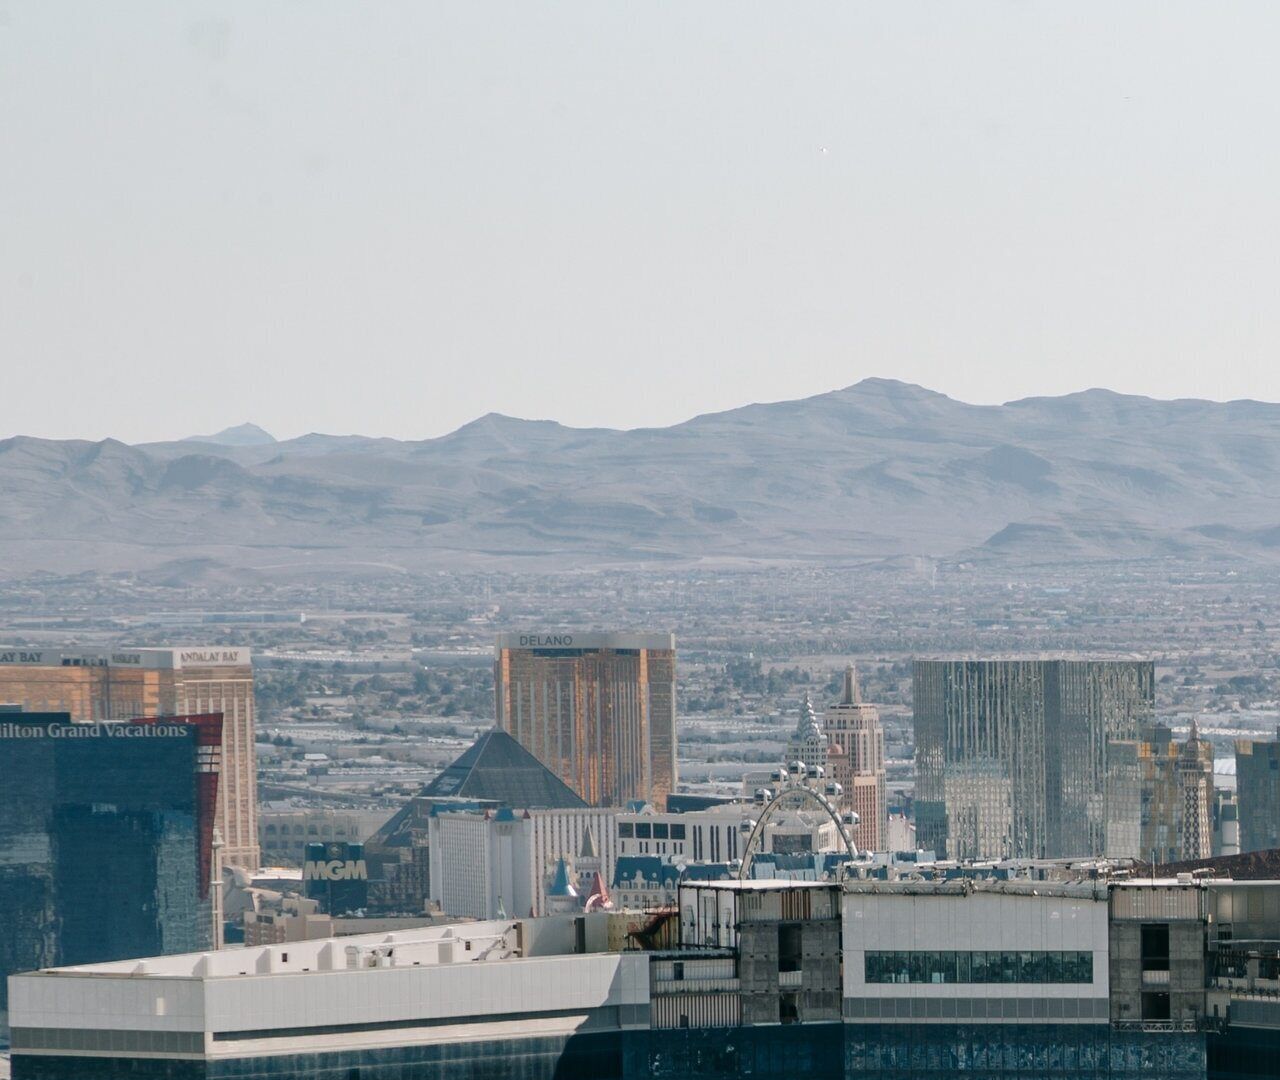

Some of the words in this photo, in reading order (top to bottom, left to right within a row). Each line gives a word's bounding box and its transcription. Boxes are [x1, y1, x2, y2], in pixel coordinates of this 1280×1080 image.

[519, 635, 573, 646] DELANO
[19, 652, 43, 662] BAY
[0, 722, 44, 738] ilton
[48, 722, 101, 738] Grand
[104, 722, 188, 738] Vacations
[304, 860, 368, 880] MGM
